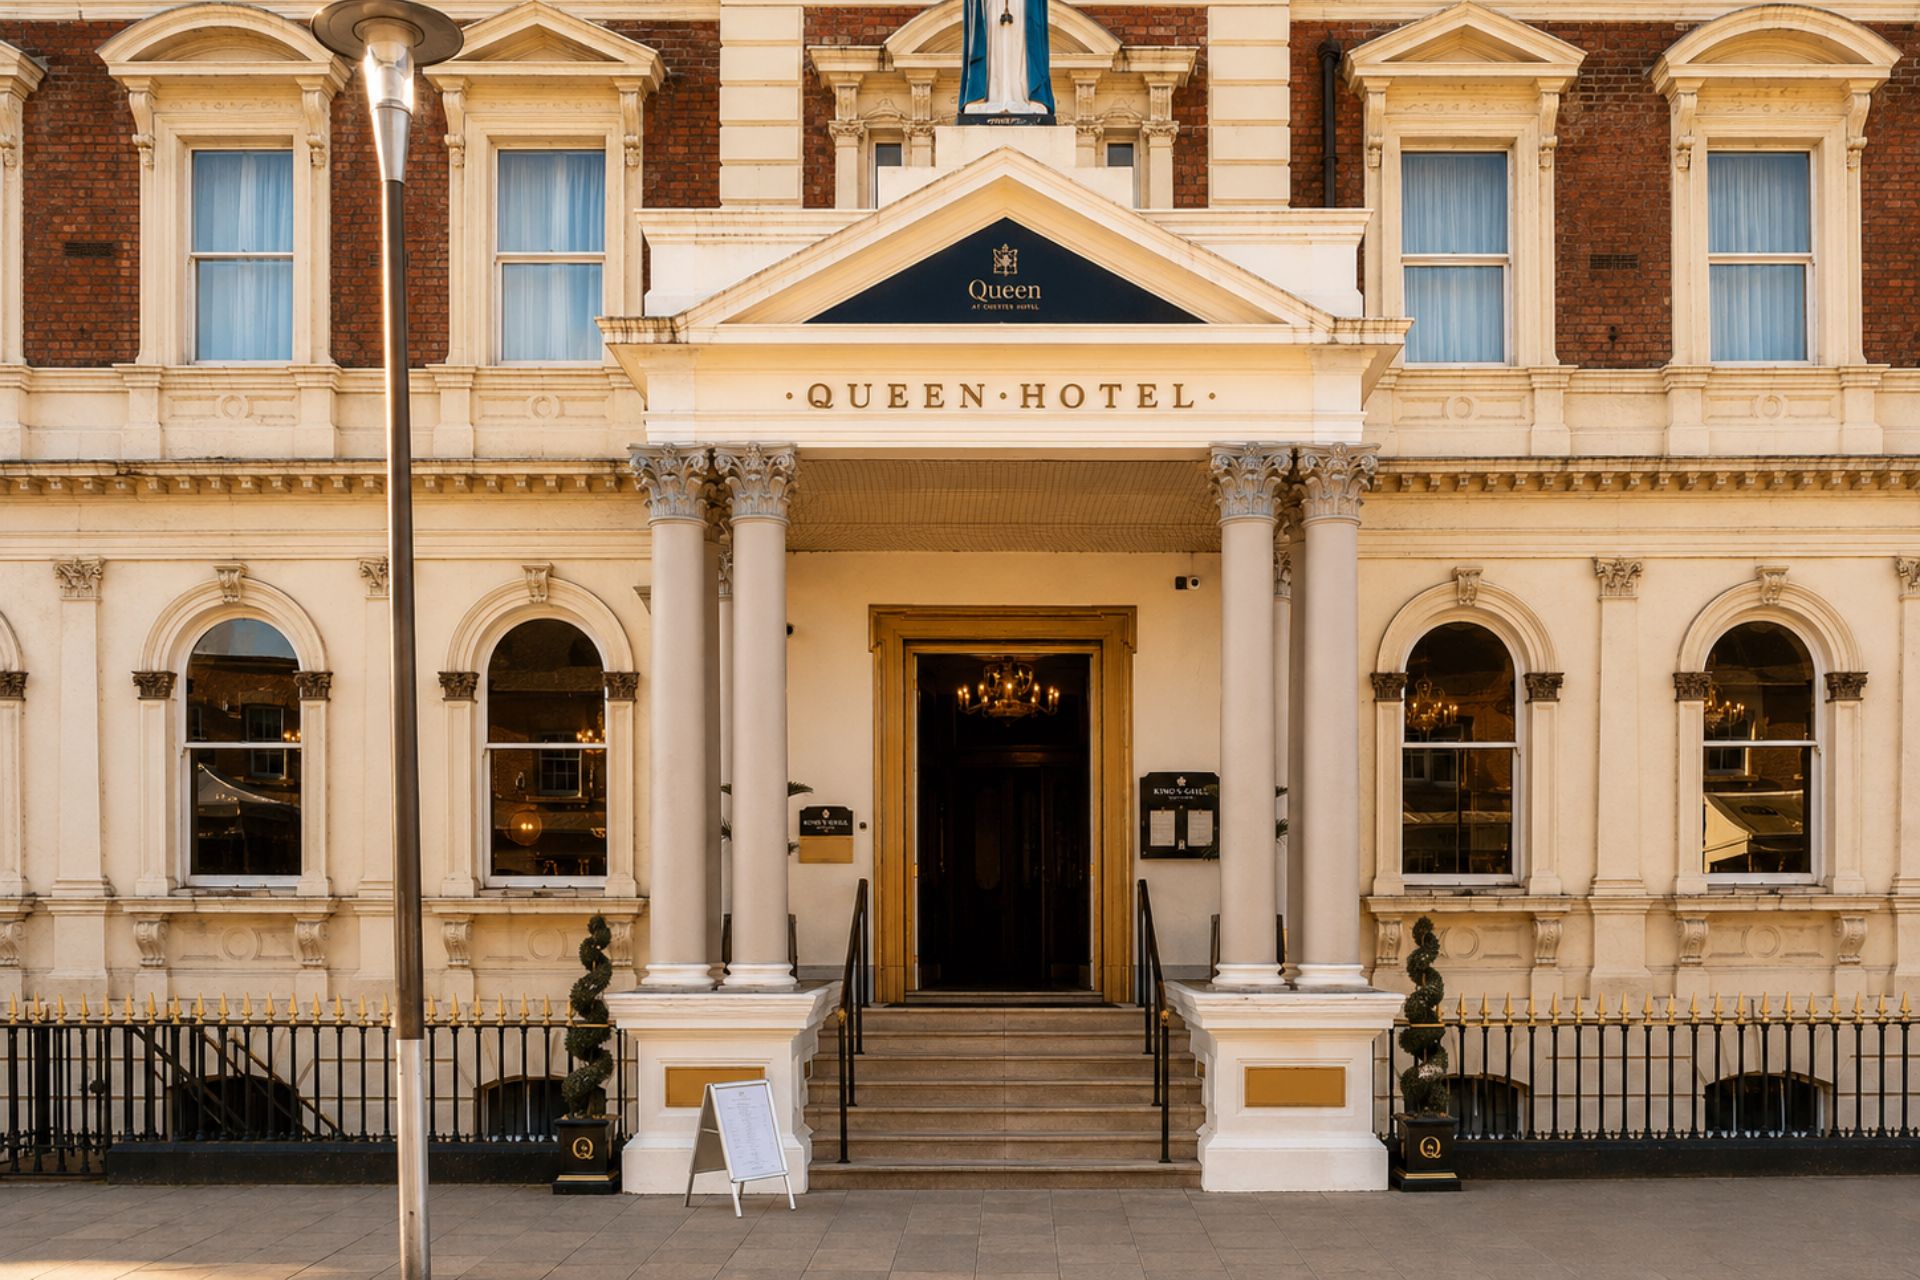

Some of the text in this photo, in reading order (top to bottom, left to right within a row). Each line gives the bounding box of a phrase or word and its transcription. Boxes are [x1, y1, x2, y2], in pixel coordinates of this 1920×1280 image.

[968, 279, 1041, 303] Queen
[807, 383, 1194, 409] QUEEN HOTEL
[572, 1136, 595, 1160] Q
[1419, 1136, 1441, 1159] Q
